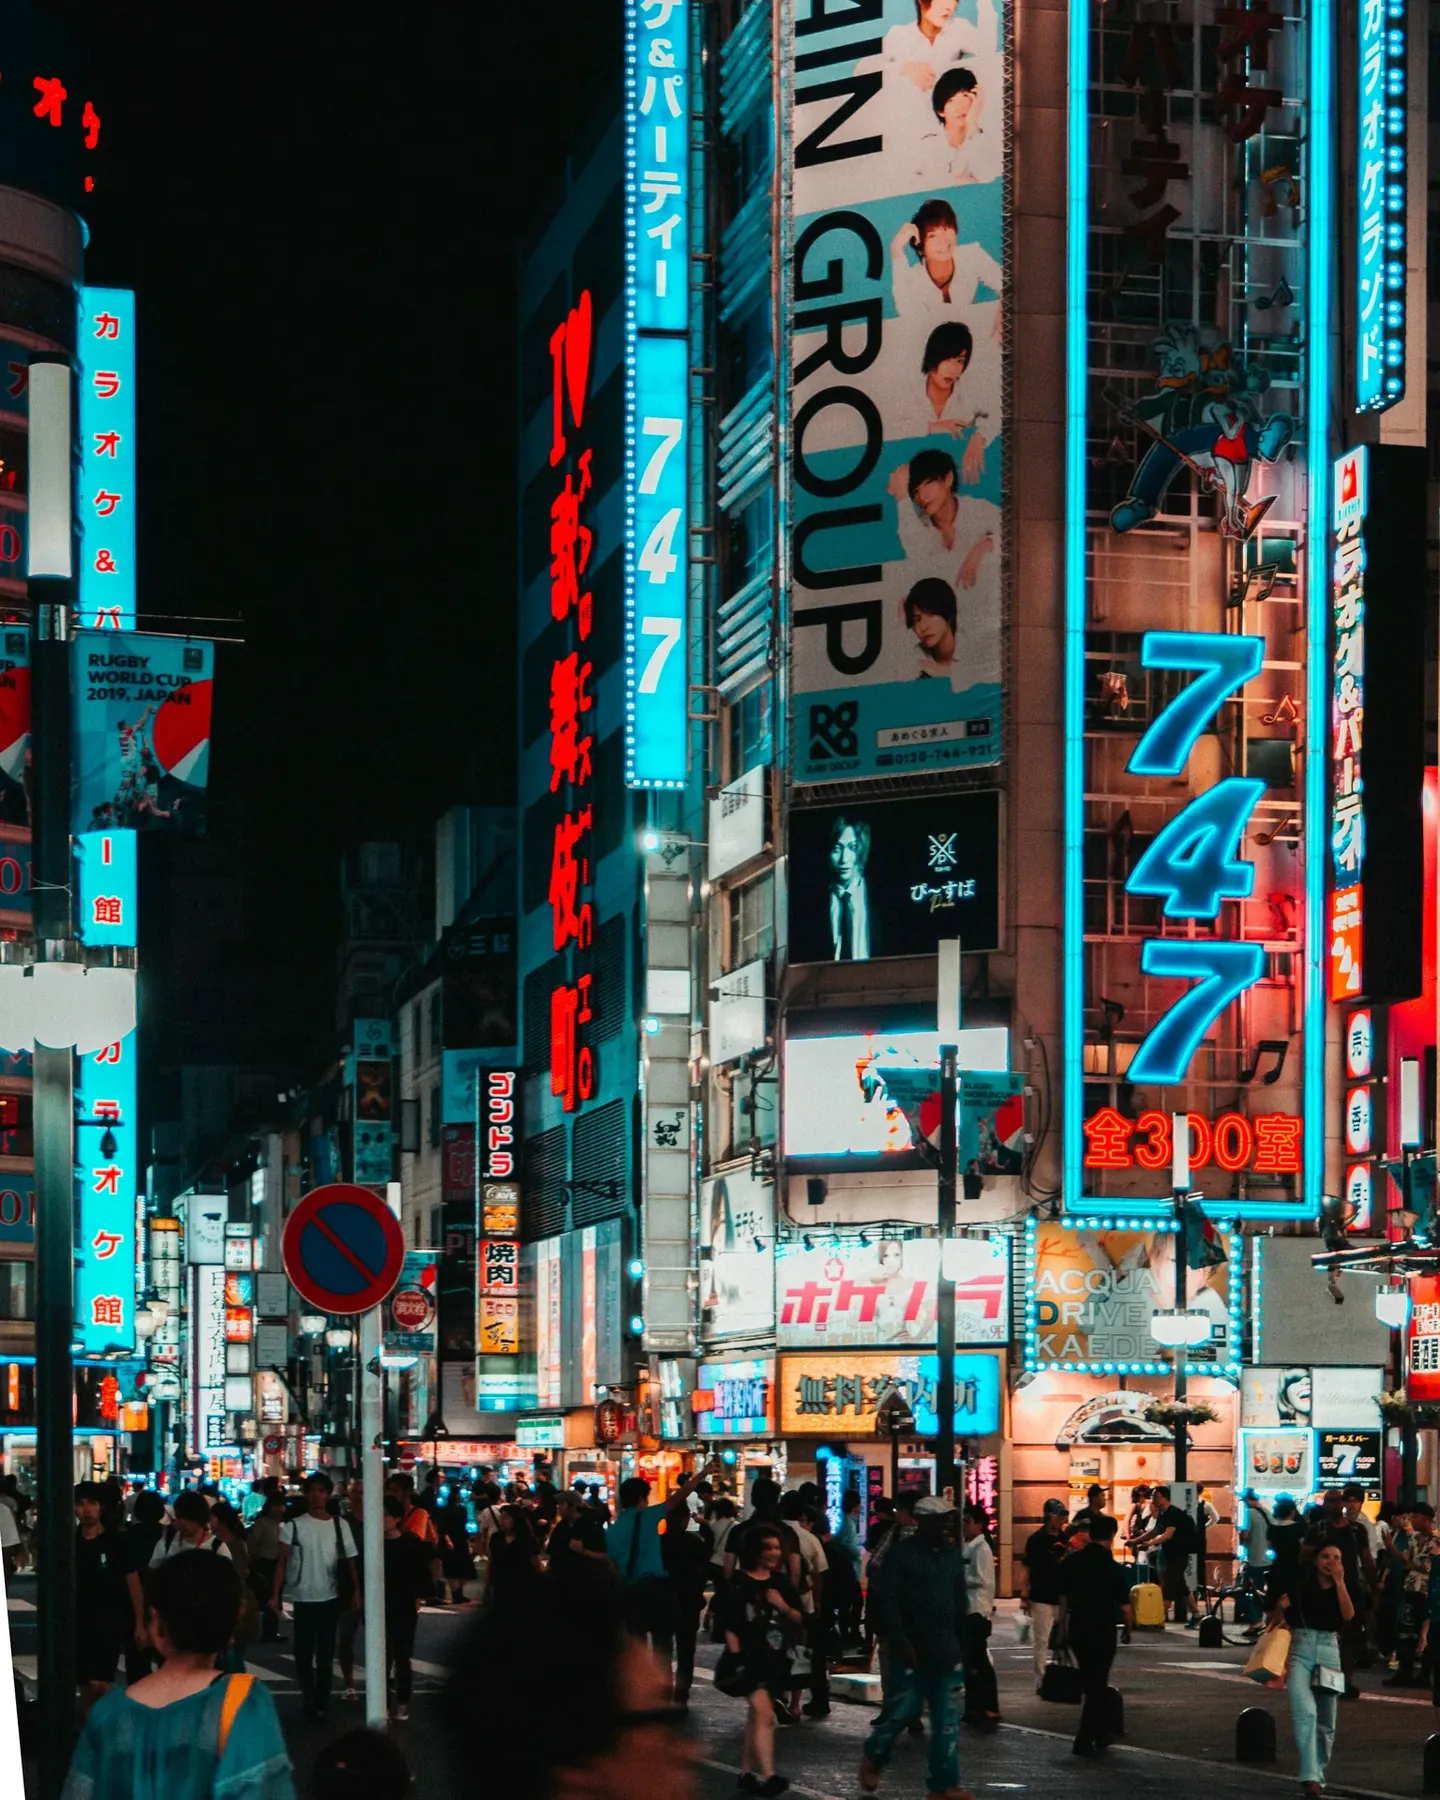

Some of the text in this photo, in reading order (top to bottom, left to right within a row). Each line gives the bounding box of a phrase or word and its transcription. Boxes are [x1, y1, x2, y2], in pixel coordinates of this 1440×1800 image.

[793, 210, 884, 676] GROUP
[637, 416, 684, 693] 747
[87, 653, 150, 669] RUGBY
[87, 670, 192, 688] WORLD CUP
[87, 688, 192, 706] 2019, JAPAN
[1124, 630, 1267, 1086] 747
[485, 1242, 516, 1285] 焼肉
[1036, 1269, 1161, 1297] ACQUA
[395, 1301, 427, 1317] 消火栓
[1035, 1301, 1147, 1327] DRIVE
[1035, 1334, 1162, 1360] KAEDE
[1331, 1444, 1361, 1475] 7
